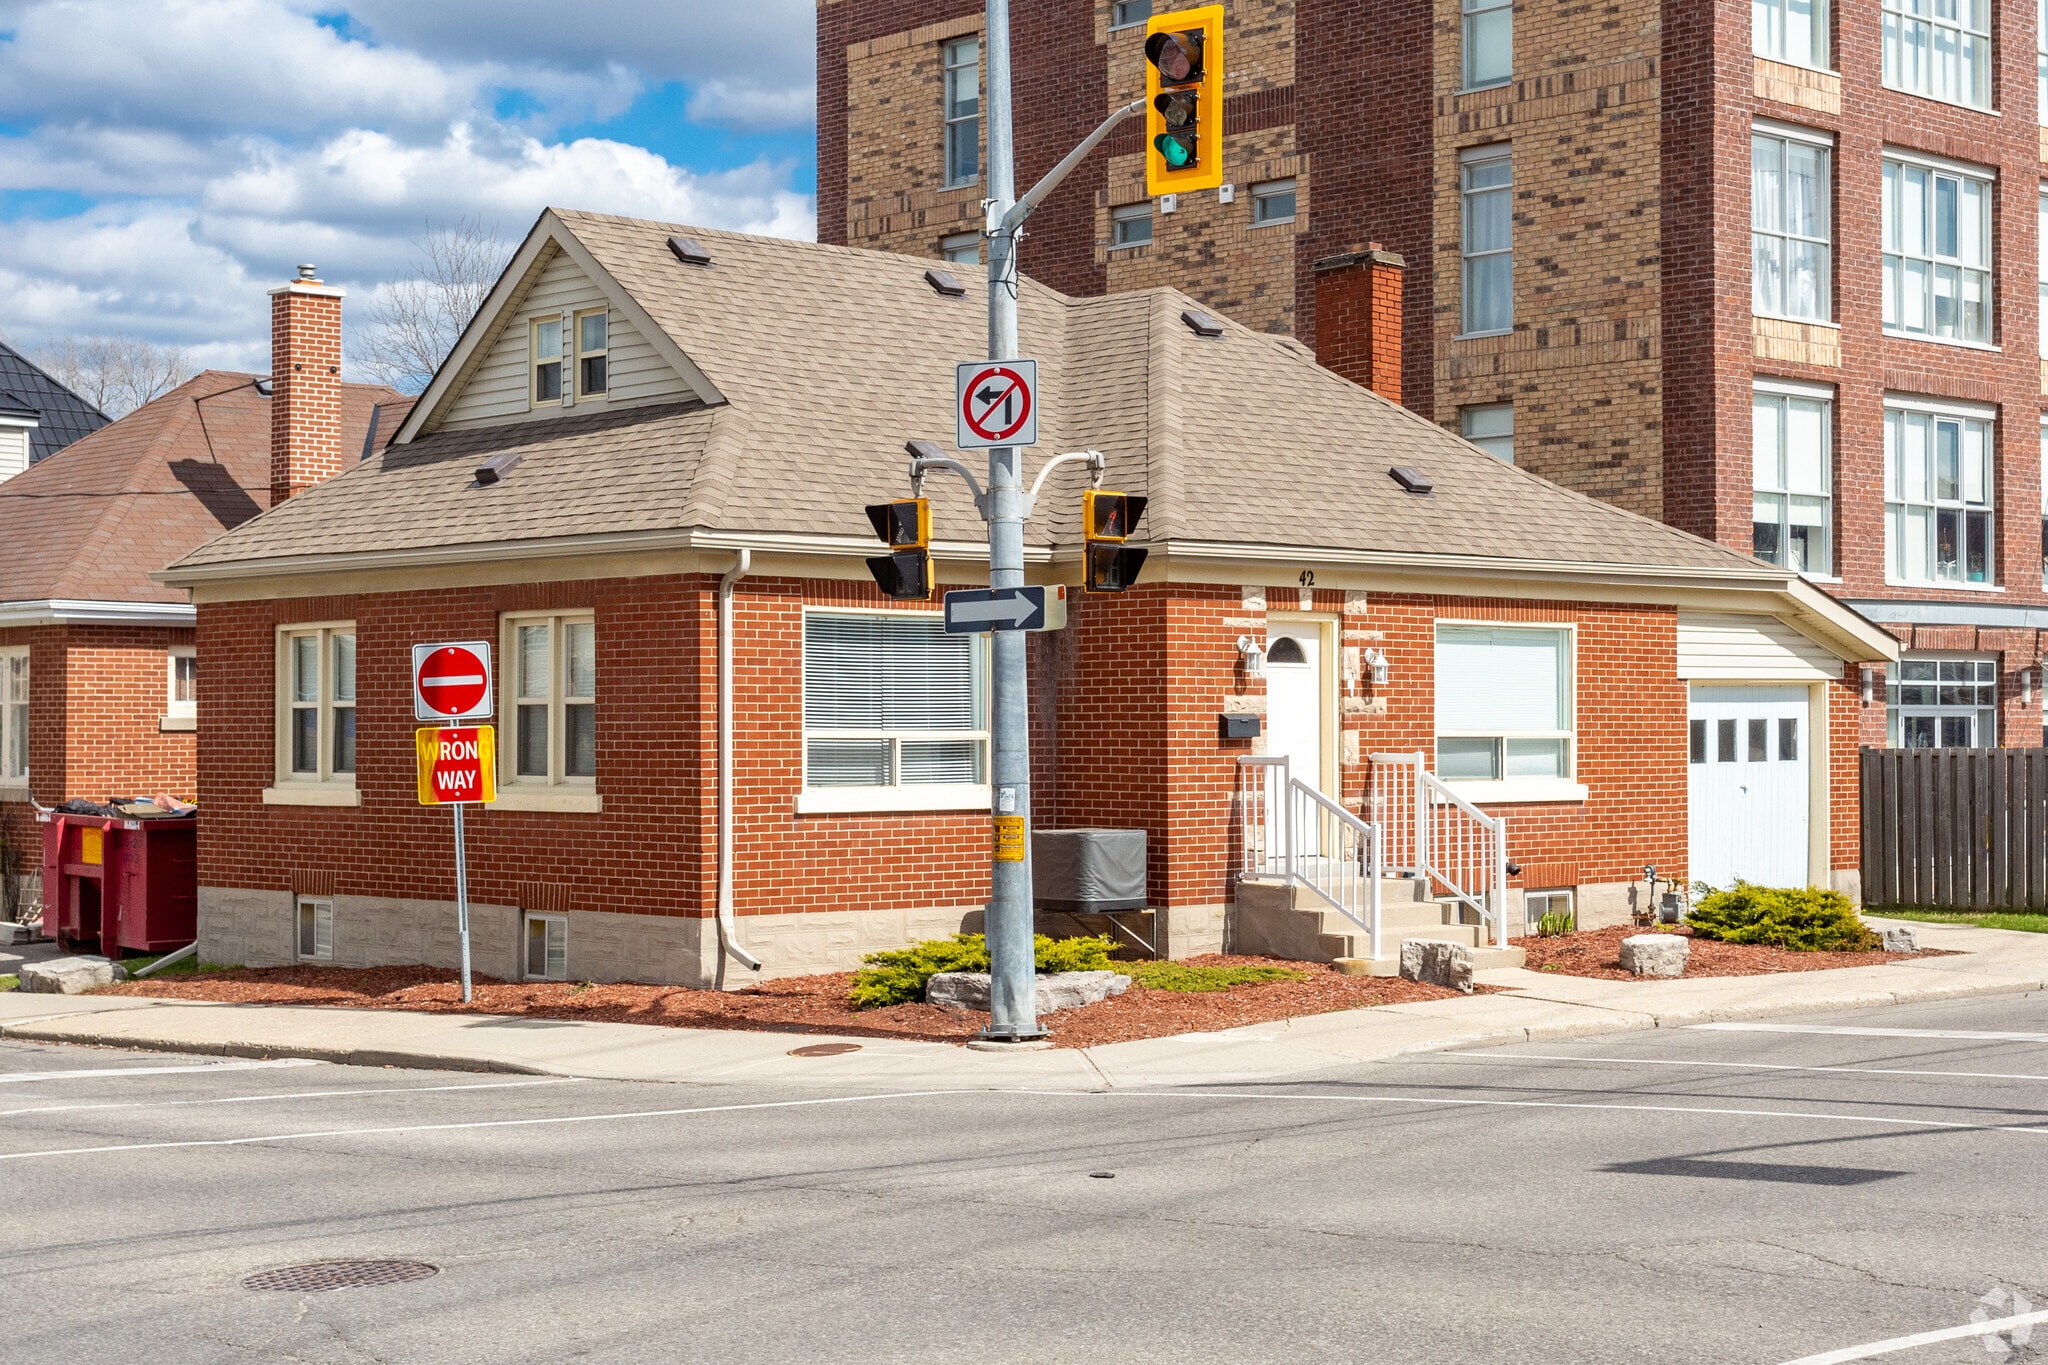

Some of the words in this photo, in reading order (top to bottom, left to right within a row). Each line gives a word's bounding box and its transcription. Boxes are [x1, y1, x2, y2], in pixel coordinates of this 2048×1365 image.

[1299, 570, 1315, 586] 42
[421, 740, 491, 761] WRONG
[437, 770, 476, 790] WAY
